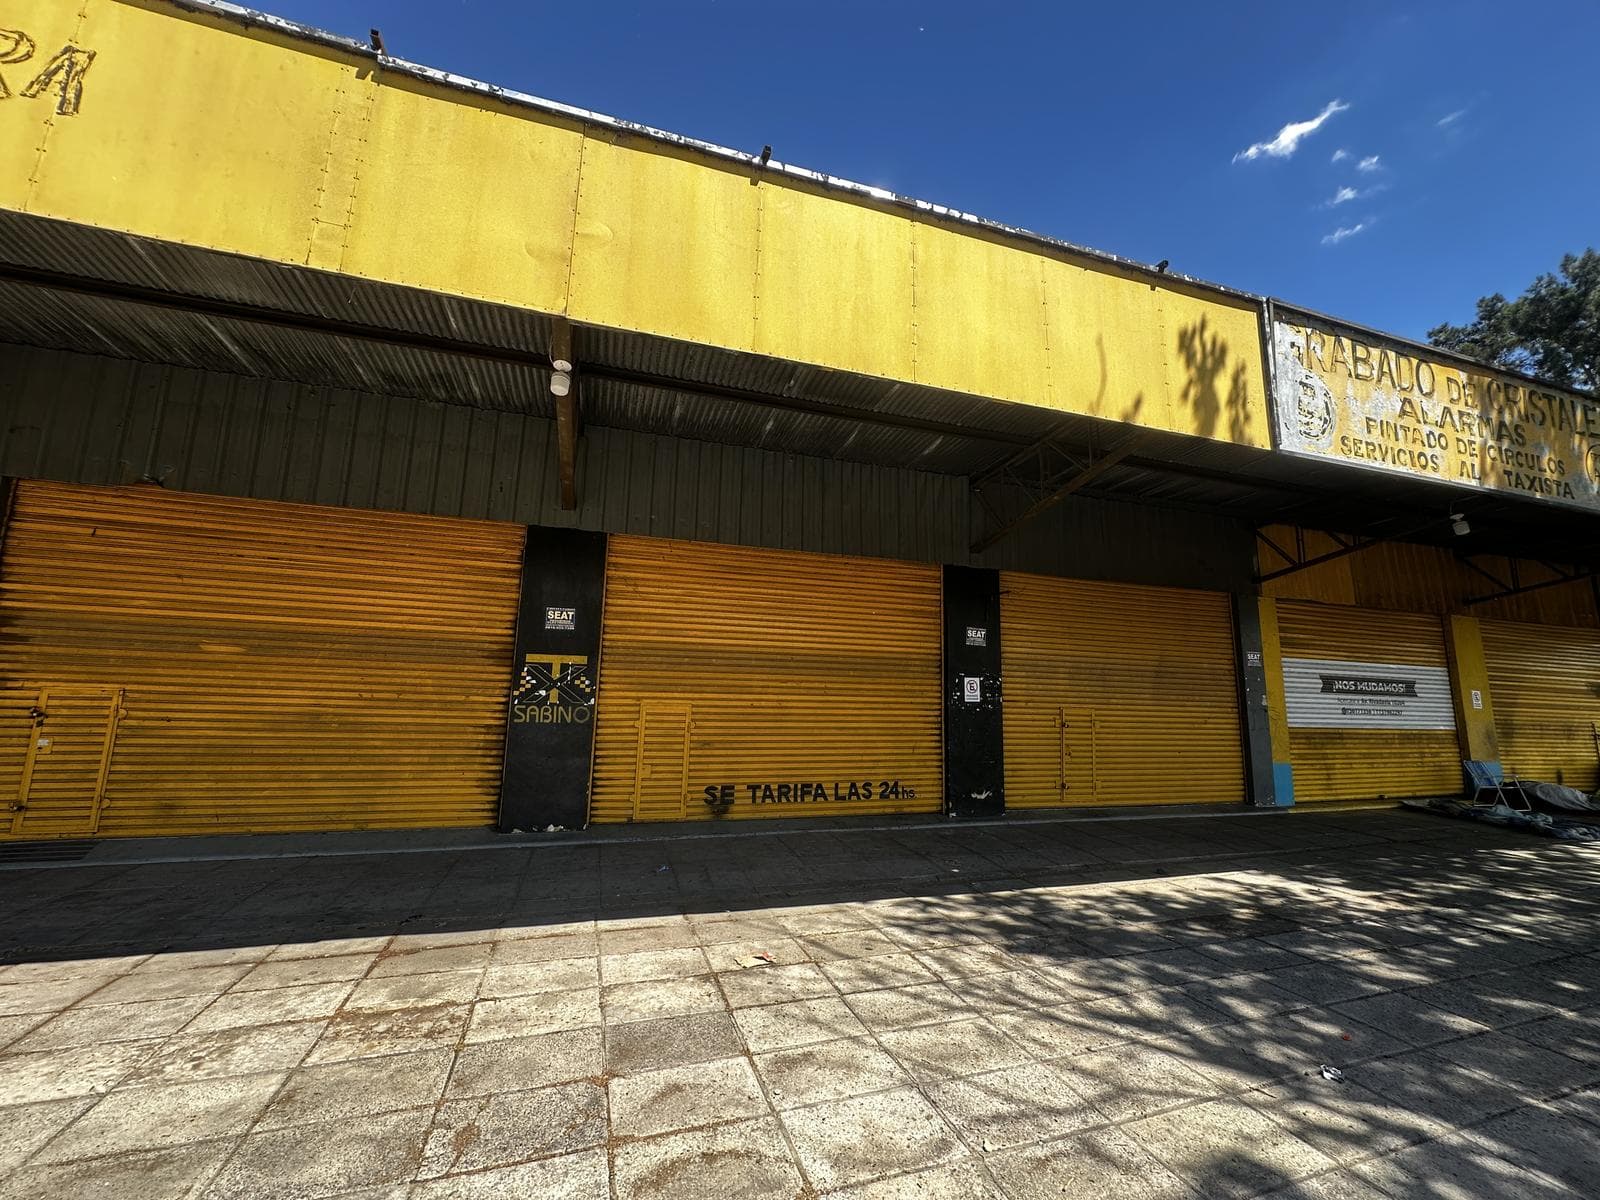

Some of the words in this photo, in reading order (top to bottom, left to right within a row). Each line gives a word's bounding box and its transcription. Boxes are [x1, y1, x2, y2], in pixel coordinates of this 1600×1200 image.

[1446, 376, 1478, 409] DE
[1398, 396, 1527, 447] ALARMAS
[1366, 417, 1448, 451] PINTADO
[1456, 437, 1479, 459] DE
[1487, 444, 1565, 475] CIRCULOS
[1340, 435, 1440, 472] SERVICIOS
[1460, 460, 1481, 480] AL
[1503, 470, 1575, 499] TAXISTA
[547, 610, 575, 620] SEAT
[967, 629, 986, 638] SEAT
[513, 705, 591, 724] SABINO
[703, 784, 735, 806] SE
[746, 783, 828, 805] TARIFA
[834, 781, 873, 801] LAS
